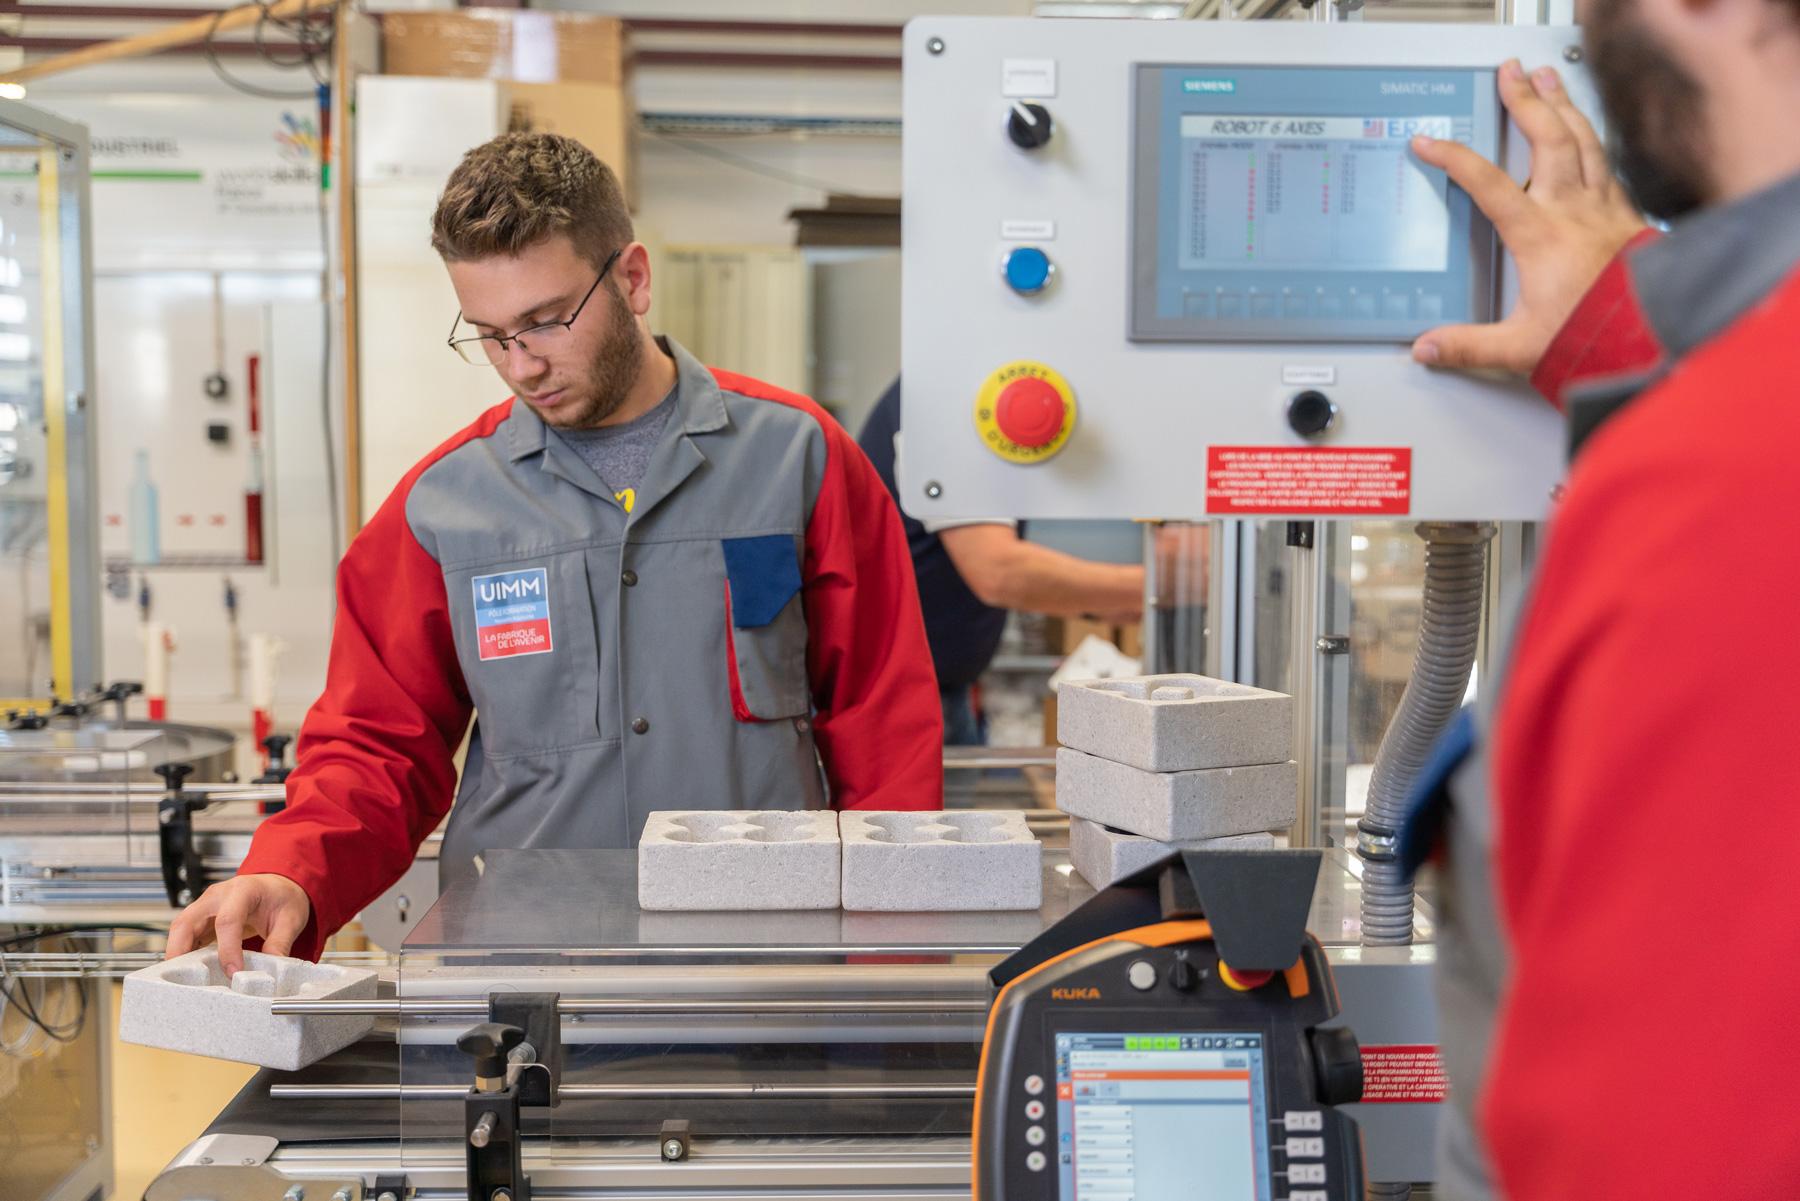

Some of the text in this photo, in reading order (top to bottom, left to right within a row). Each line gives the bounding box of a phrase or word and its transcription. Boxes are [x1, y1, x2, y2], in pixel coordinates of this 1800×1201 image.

[1184, 80, 1233, 92] SIEMENS
[1379, 81, 1456, 96] SIMATIC HMI
[1211, 119, 1326, 135] ROBOT 6 AXES
[480, 576, 540, 602] UIMM
[485, 628, 536, 643] LA FABRIQUE
[498, 635, 545, 649] DE L'AVENIR
[1051, 986, 1102, 1000] KUKA
